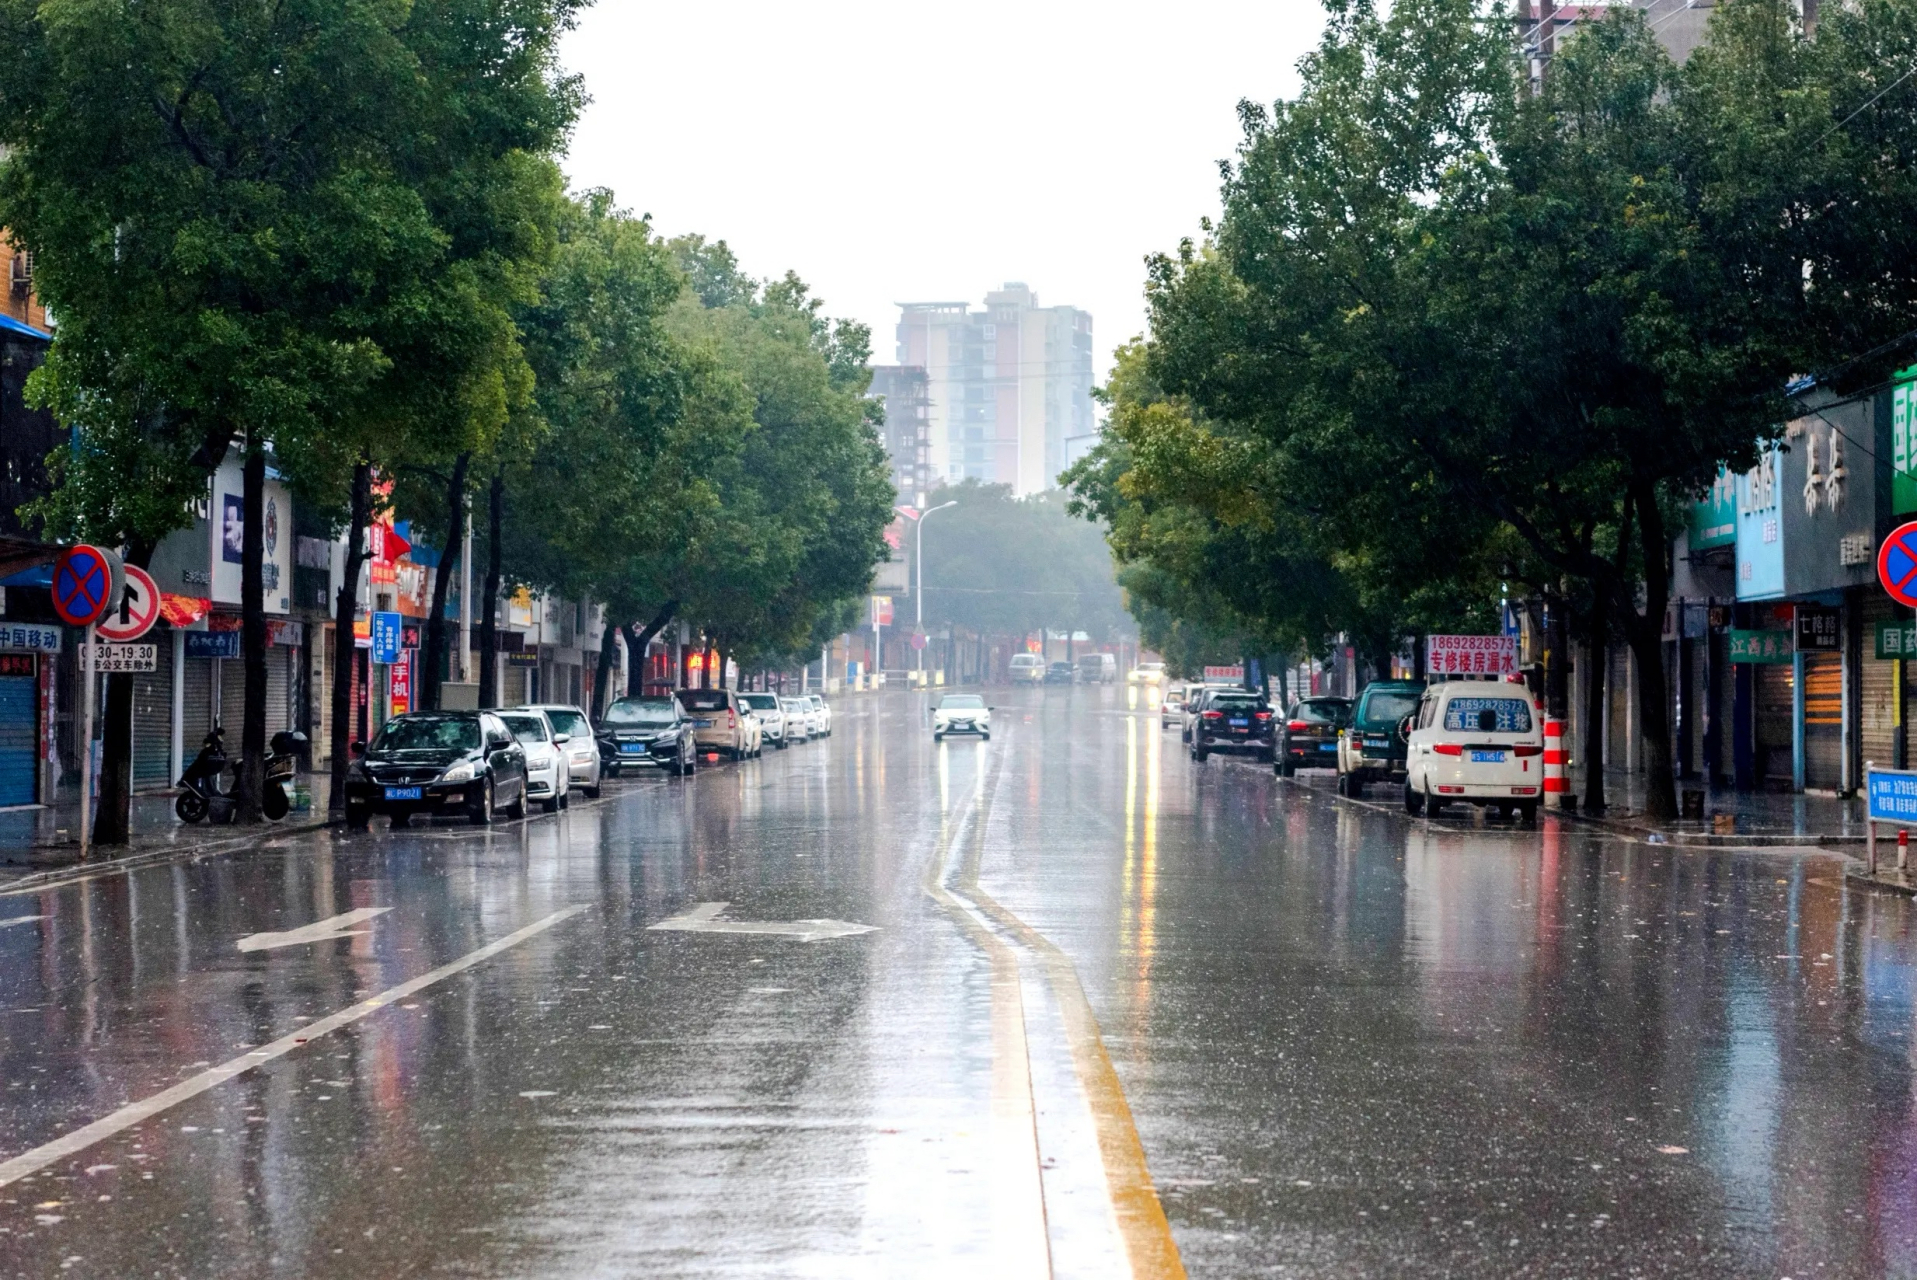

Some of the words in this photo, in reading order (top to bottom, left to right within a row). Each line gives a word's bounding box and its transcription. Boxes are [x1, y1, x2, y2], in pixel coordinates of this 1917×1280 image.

[0, 627, 57, 648] 中国移动
[1431, 636, 1514, 650] 18692828573
[81, 646, 153, 659] 0:30-19:30
[1430, 650, 1514, 673] 专修楼房漏水
[1454, 700, 1523, 711] 18692828573
